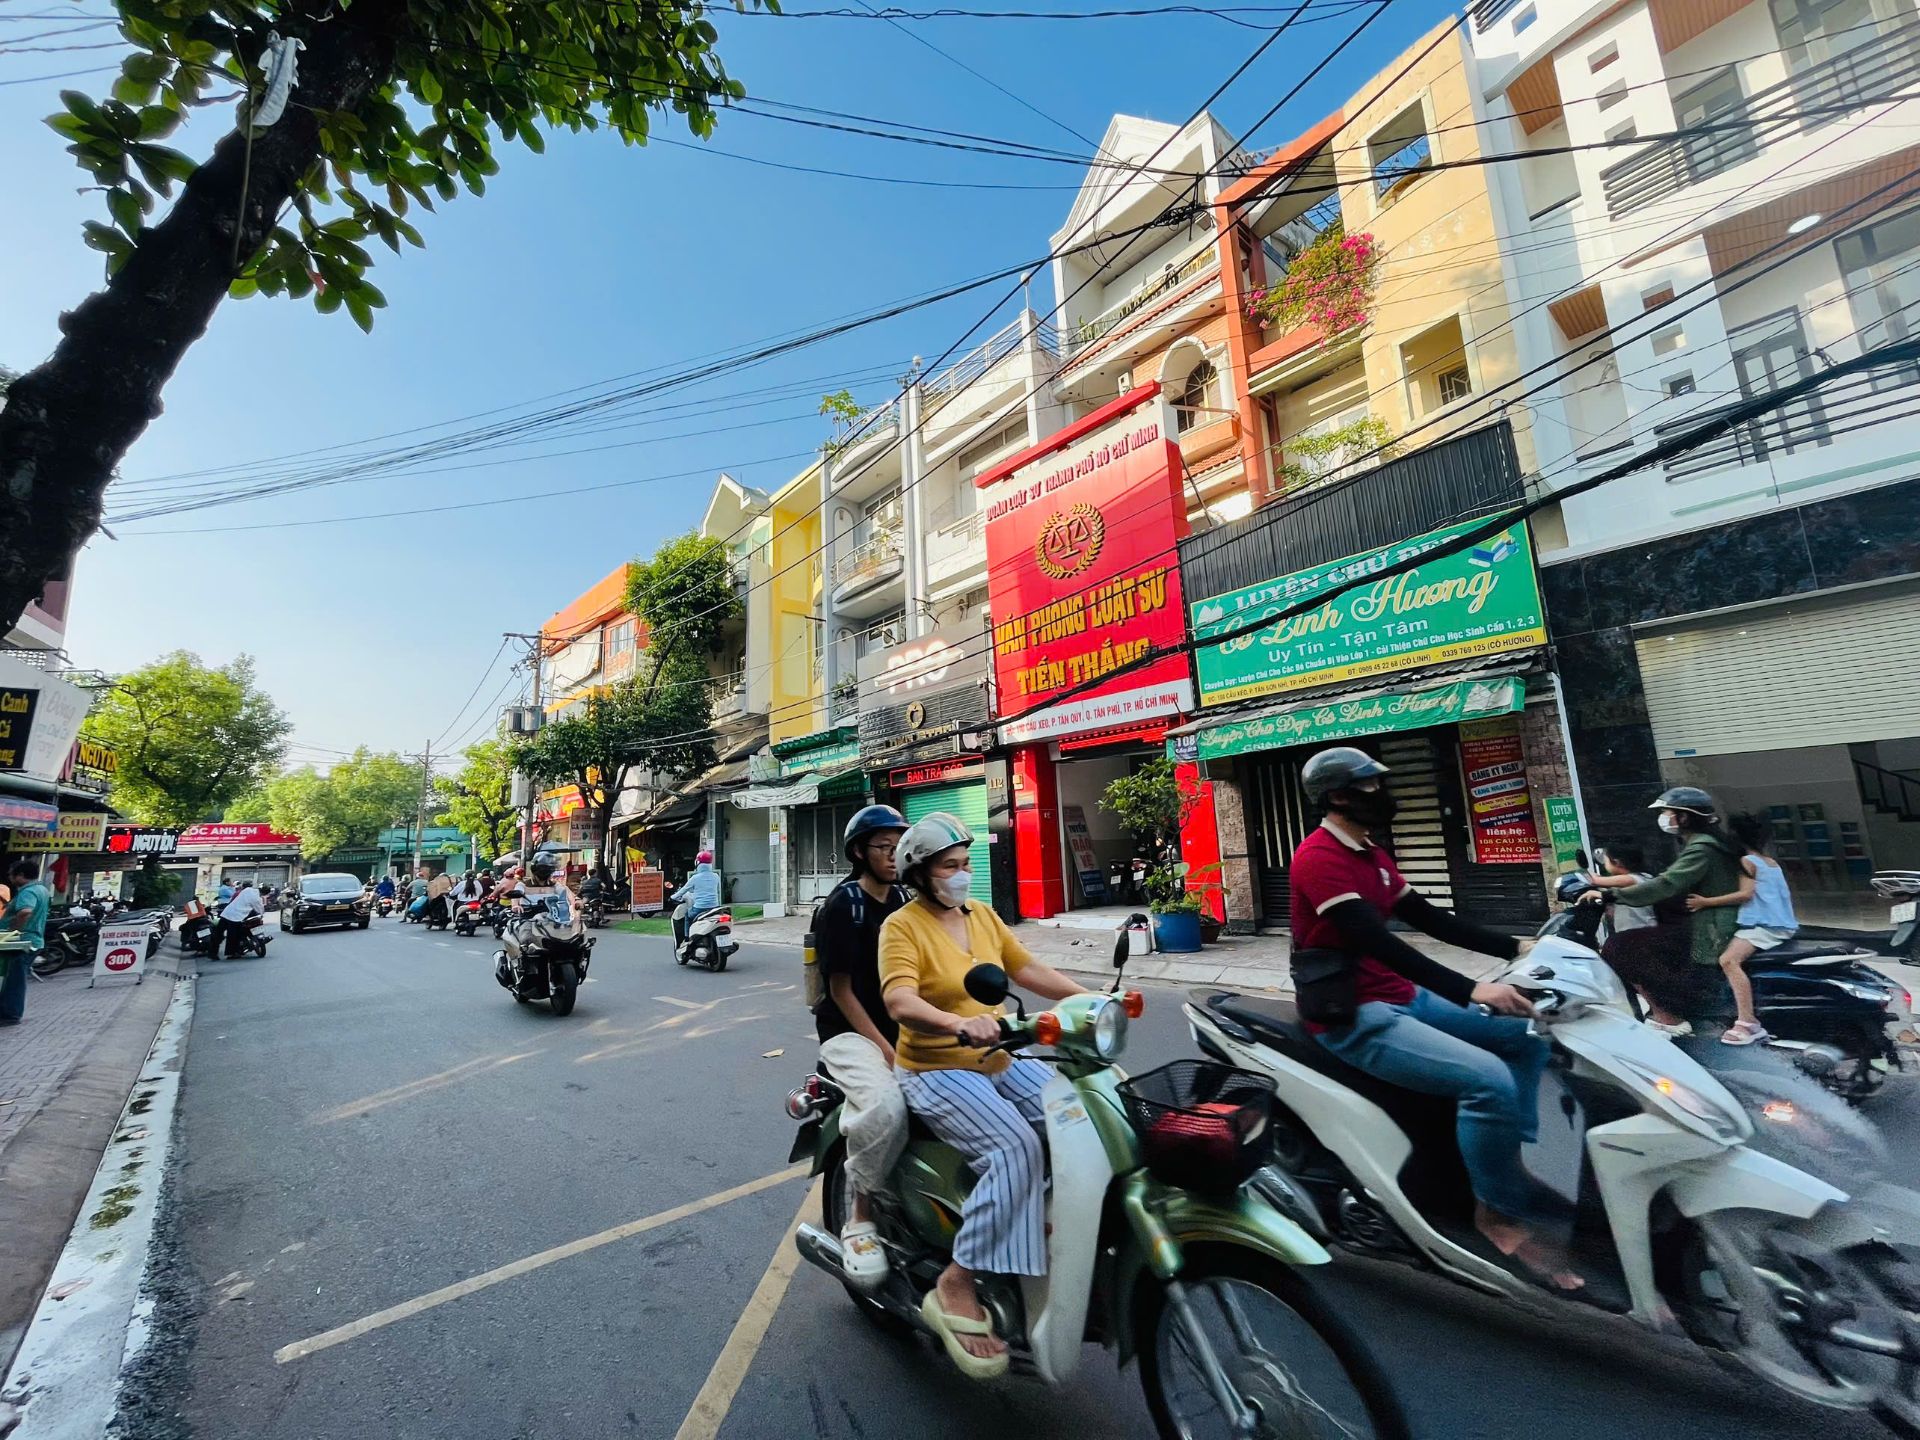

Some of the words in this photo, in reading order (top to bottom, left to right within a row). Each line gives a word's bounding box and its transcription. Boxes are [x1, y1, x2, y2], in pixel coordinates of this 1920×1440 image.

[1008, 488, 1027, 509] LUẬT
[1029, 481, 1042, 501] SƯ
[1045, 466, 1074, 493] THÀNH
[1075, 450, 1094, 479] PHỐ
[1096, 443, 1110, 469] HỒ
[1112, 432, 1129, 460] CHÍ
[1130, 423, 1158, 451] MINH
[1235, 573, 1319, 610] LUYỆN
[1327, 550, 1389, 584] CHỮ
[996, 613, 1029, 656] VĂN
[1030, 596, 1087, 647] PHÒNG
[1089, 576, 1136, 628] LUẬT
[1137, 566, 1168, 614] SƯ
[1260, 600, 1344, 645] Linh
[1351, 568, 1500, 623] Hương
[1204, 680, 1225, 690] Chuyên
[1238, 674, 1255, 685] Luyện
[1255, 670, 1268, 680] Chữ
[1269, 668, 1281, 677] Cho
[1282, 664, 1295, 675] Các
[1305, 657, 1327, 671] Chuẩn
[1336, 653, 1350, 664] Vào
[1350, 651, 1364, 663] Lớp
[1376, 643, 1389, 655] Cải
[1390, 640, 1412, 652] Thiện
[1412, 636, 1428, 647] Chữ
[1430, 633, 1445, 645] Cho
[1447, 629, 1464, 643] Học
[1465, 625, 1486, 637] Sinh
[1487, 619, 1505, 635] Cấp
[1506, 620, 1516, 631] 1,
[1517, 618, 1527, 630] 2,
[1528, 615, 1536, 625] 3
[1268, 649, 1291, 664] Uy
[1295, 641, 1325, 657] Tín
[1341, 630, 1377, 647] Tận
[1383, 619, 1429, 638] Tâm
[1016, 655, 1066, 696] TIẾN
[1069, 637, 1151, 684] THẮNG
[1254, 683, 1265, 693] TÂN
[1299, 675, 1308, 686] HỒ
[1308, 674, 1319, 684] CHÍ
[1319, 672, 1334, 682] MINH
[1382, 662, 1390, 670] 22
[1390, 660, 1398, 669] 68
[1399, 657, 1412, 668] (CÔ
[1412, 653, 1431, 665] LINH)
[1441, 648, 1458, 659] 0339
[1459, 646, 1473, 656] 769
[1473, 643, 1486, 654] 125
[1487, 639, 1502, 652] (CÔ
[1502, 634, 1534, 649] HƯƠNG)
[1, 691, 29, 714] Canh
[1057, 713, 1069, 726] TÂN
[1094, 704, 1106, 719] TÂN
[1134, 696, 1144, 712] HỒ
[1145, 693, 1157, 708] CHÍ
[1159, 692, 1179, 707] MINH
[1339, 700, 1384, 723] Linh
[1176, 735, 1196, 748] 108
[1286, 735, 1318, 745] Sinh
[1502, 762, 1520, 774] NGAY
[60, 815, 100, 827] Canh
[1552, 802, 1573, 818] LUYỆN
[211, 826, 237, 836] ANH
[239, 826, 258, 835] EM
[107, 954, 133, 966] 30K
